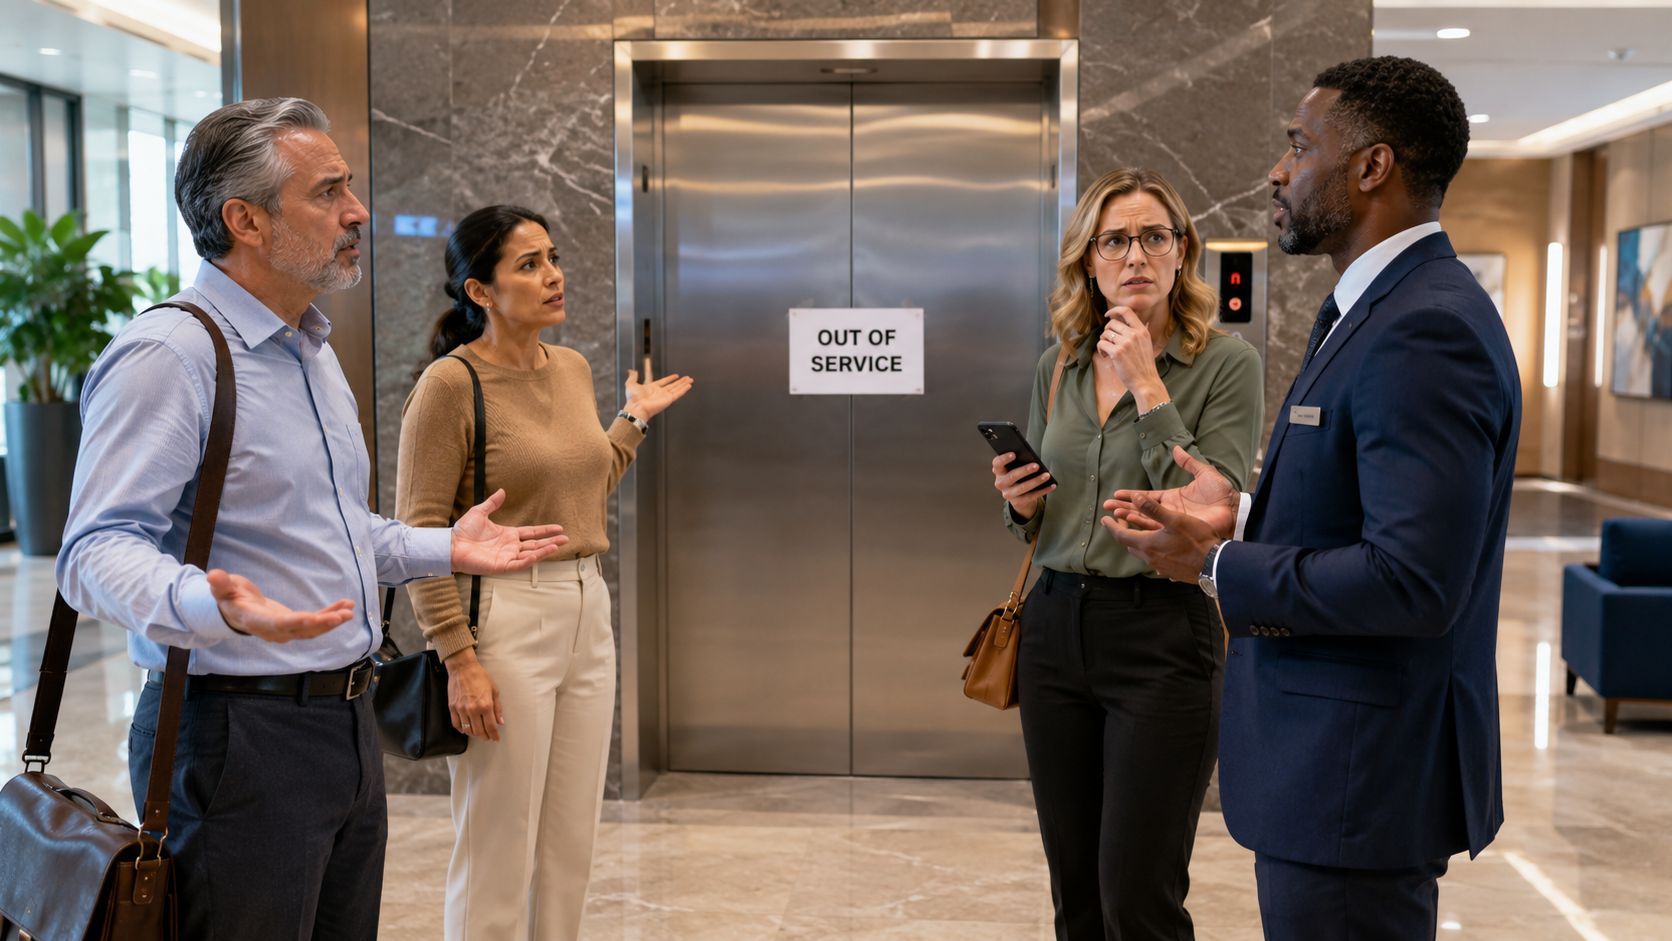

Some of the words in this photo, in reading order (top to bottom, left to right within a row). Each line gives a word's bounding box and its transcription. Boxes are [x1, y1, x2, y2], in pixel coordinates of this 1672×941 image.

[818, 329, 861, 346] OUT
[868, 329, 896, 346] OF
[811, 355, 903, 372] SERVICE
